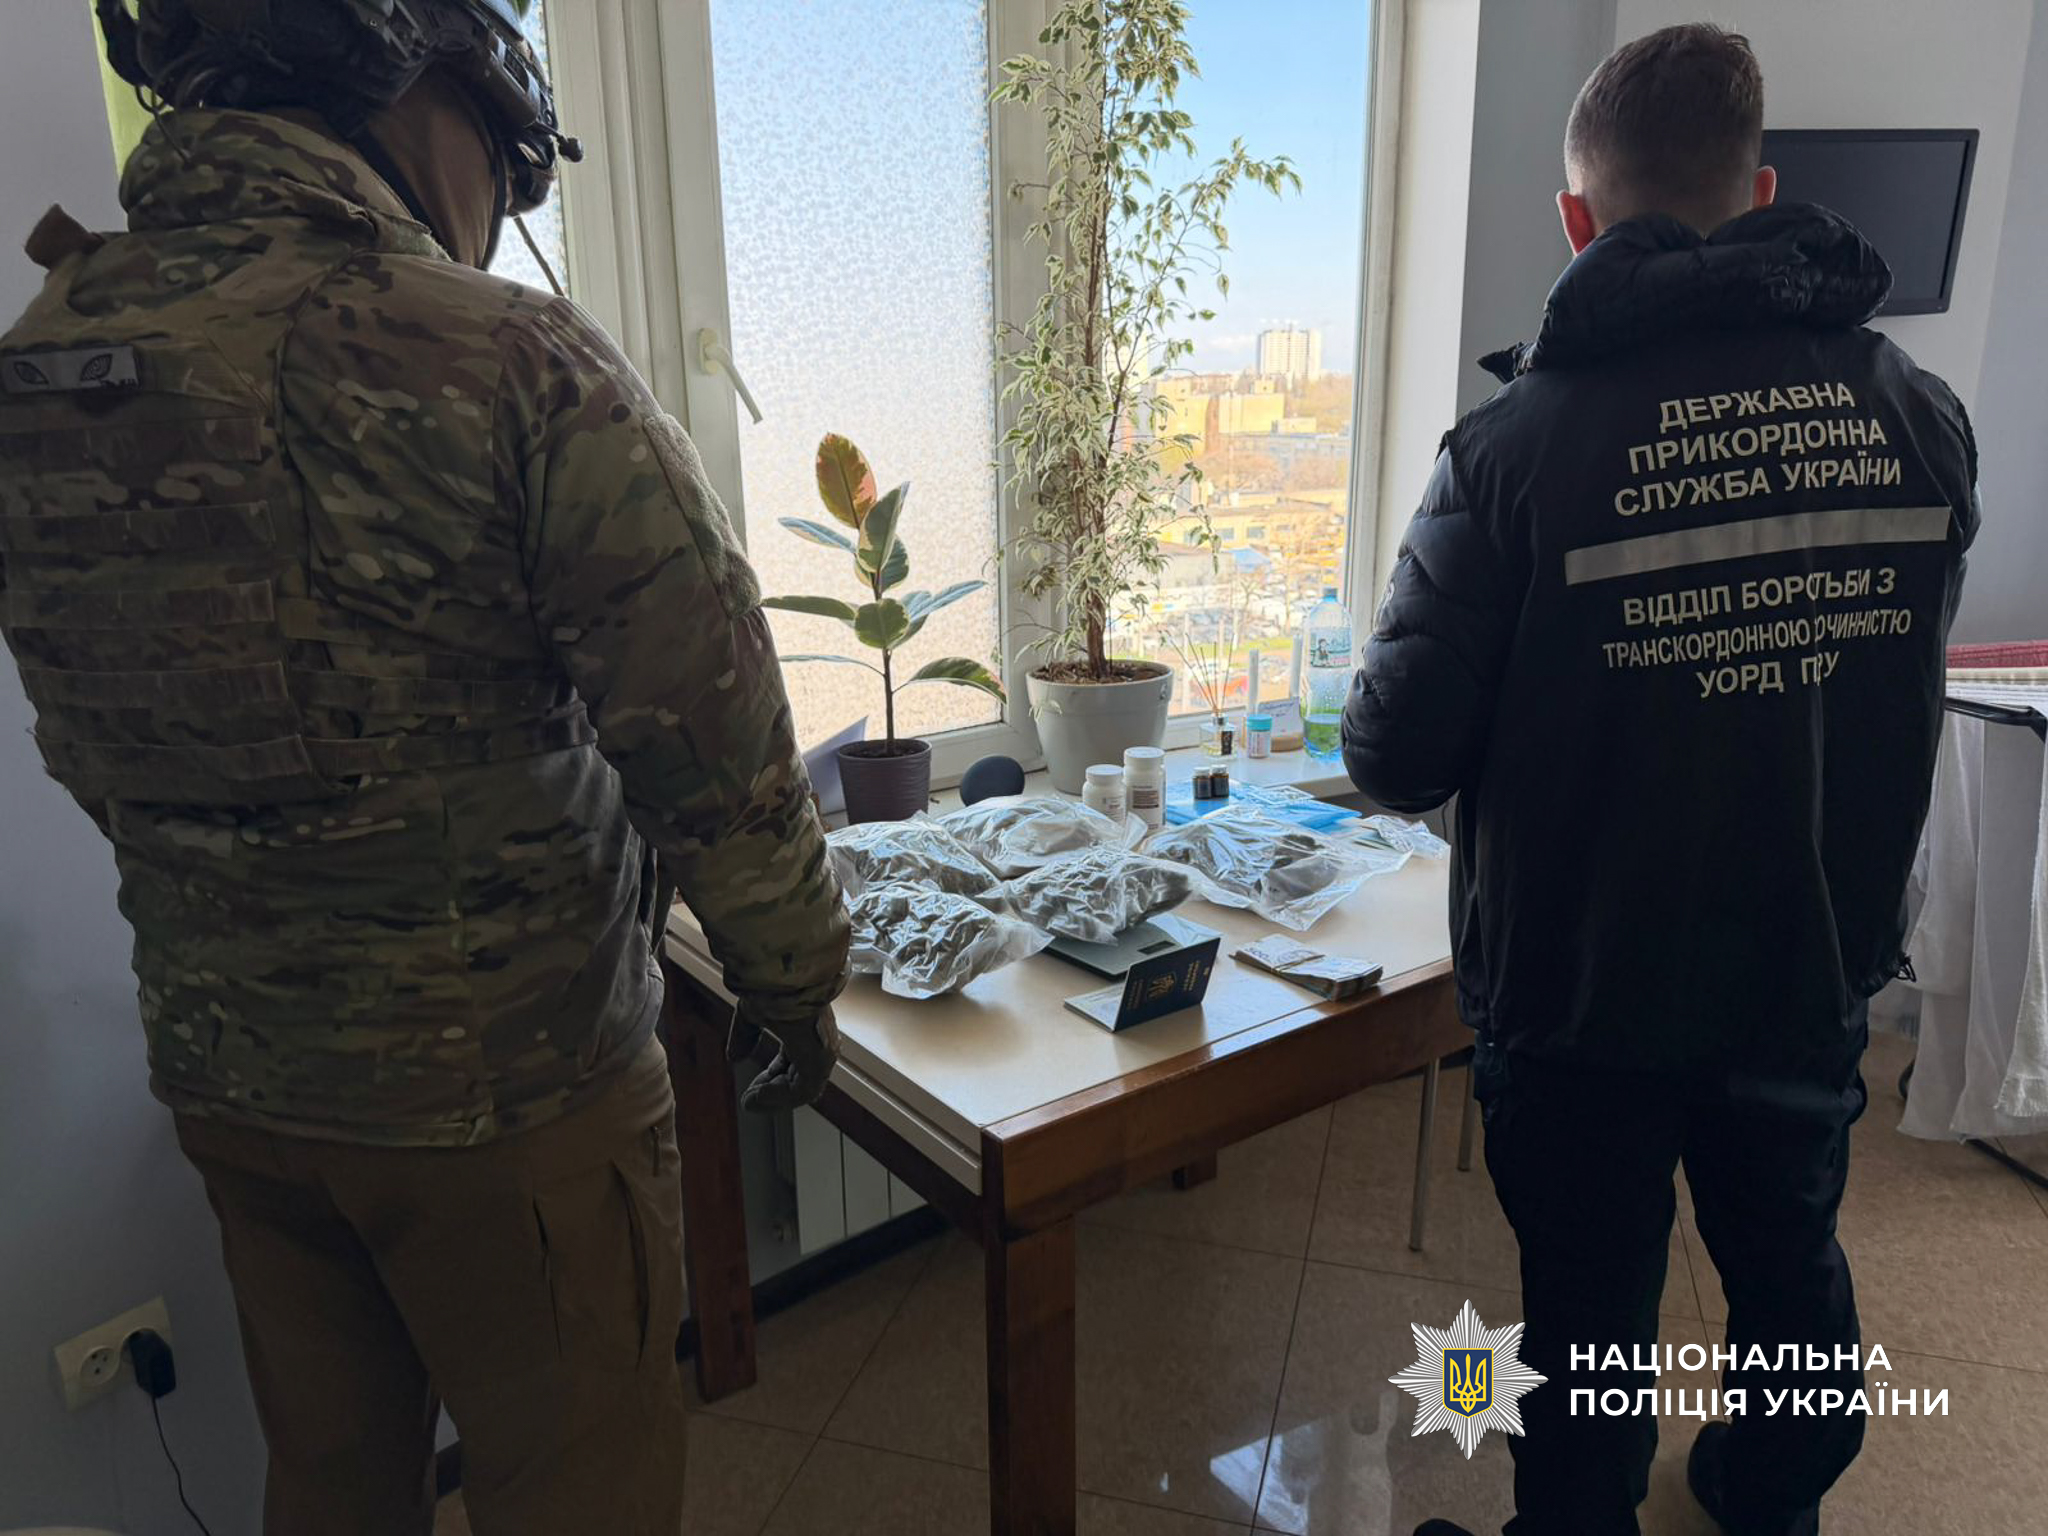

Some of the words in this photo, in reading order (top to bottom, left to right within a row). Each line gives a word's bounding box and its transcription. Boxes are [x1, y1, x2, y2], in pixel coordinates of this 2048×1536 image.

[1660, 383, 1855, 433] ДЕРЖАВНА
[1629, 419, 1887, 473] ПРИКОРДОННА
[1615, 468, 1771, 515] СЛУЖБА
[1782, 451, 1900, 490] УКРАЇНИ
[1624, 586, 1731, 625] ВІДДІЛ
[1603, 619, 1810, 667] ТРАНСКОРДОННОЮ
[1697, 662, 1783, 697] УОРД
